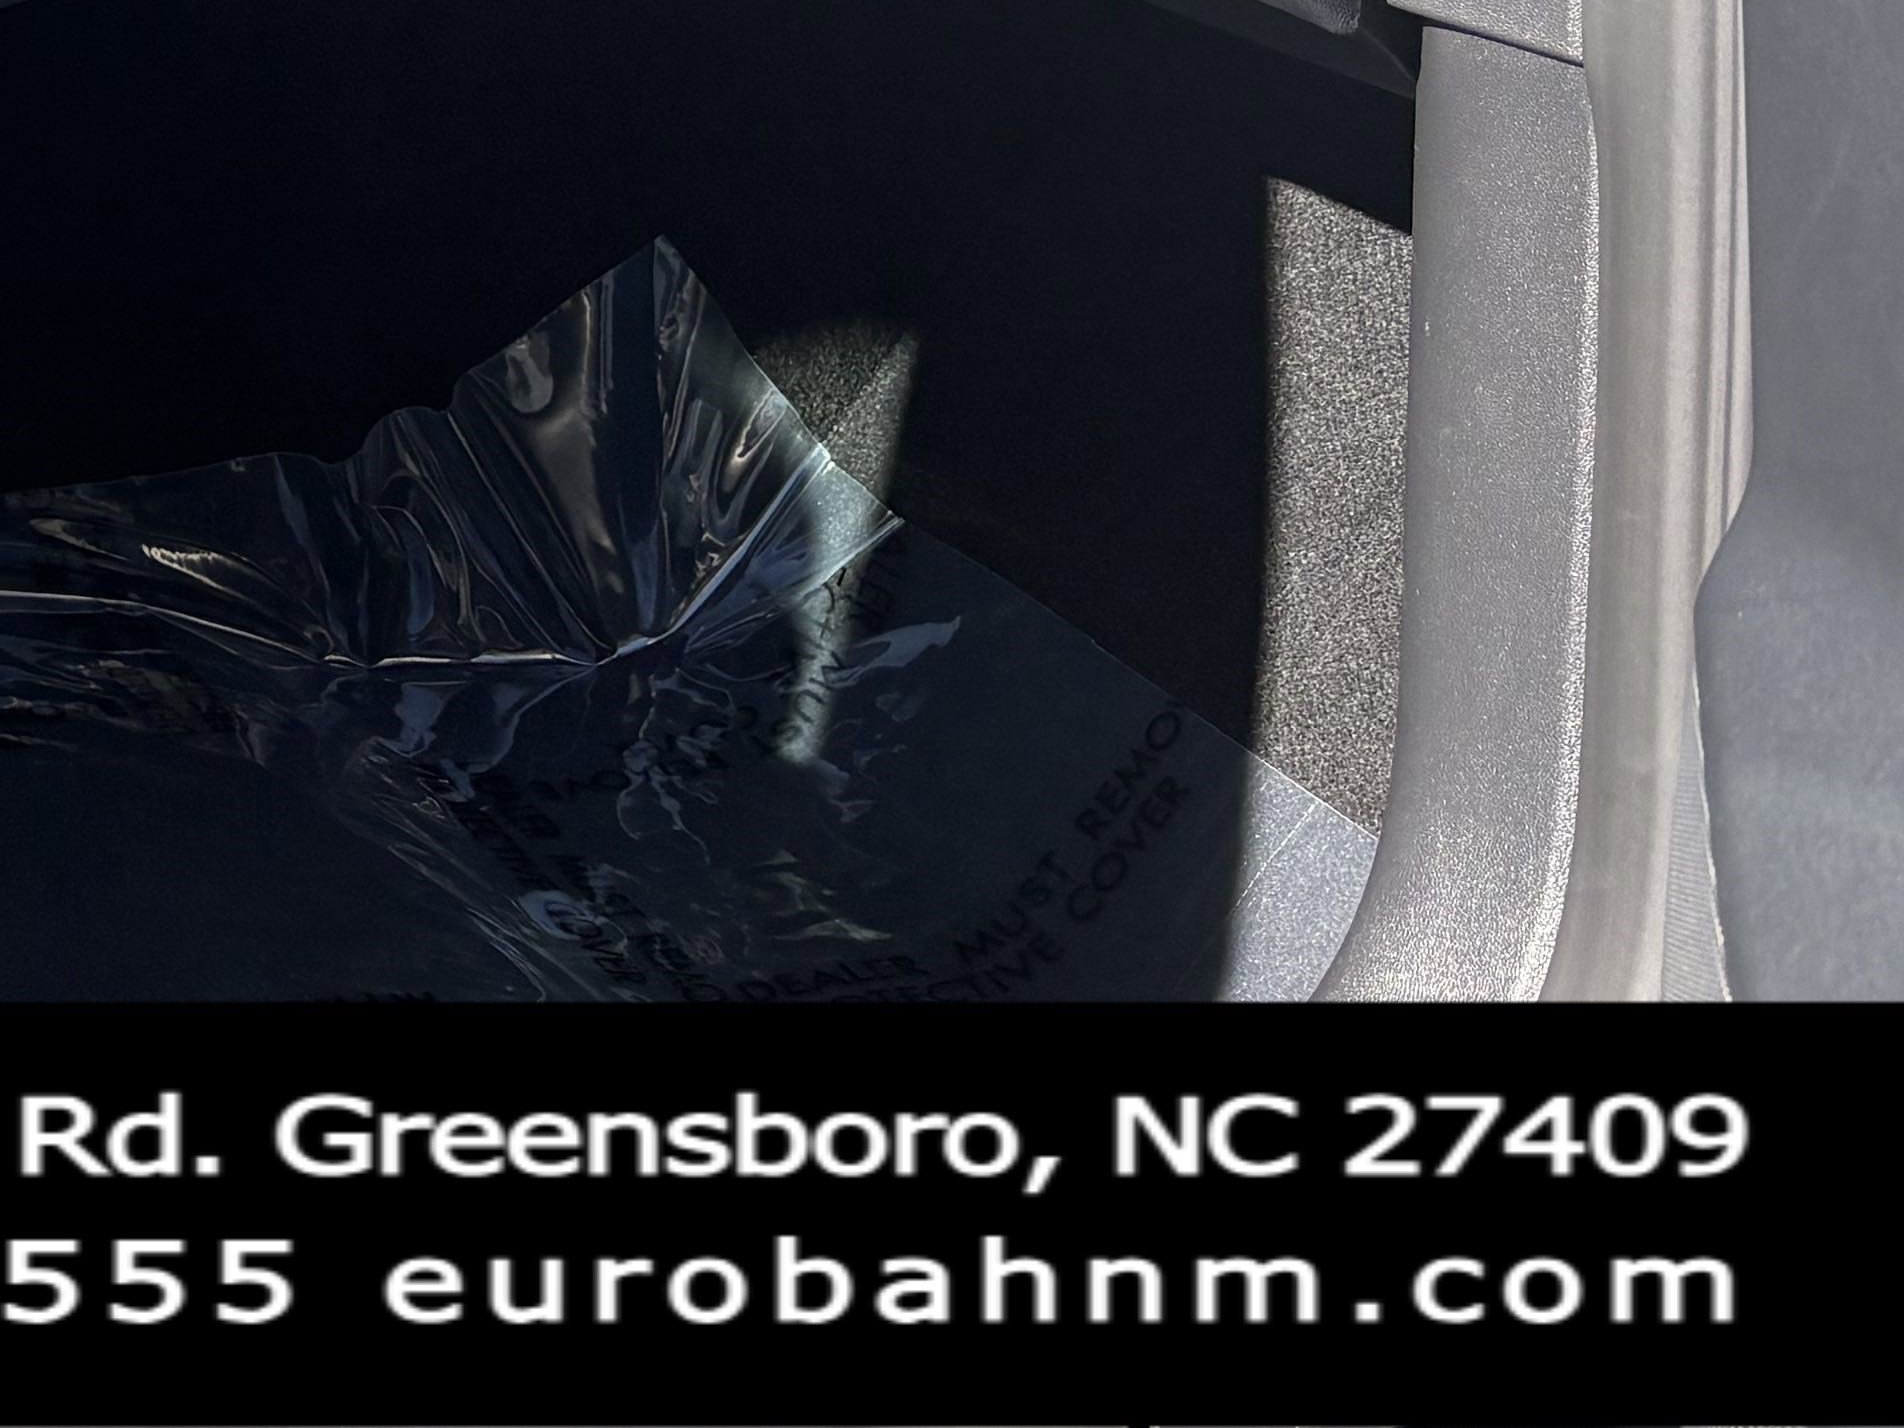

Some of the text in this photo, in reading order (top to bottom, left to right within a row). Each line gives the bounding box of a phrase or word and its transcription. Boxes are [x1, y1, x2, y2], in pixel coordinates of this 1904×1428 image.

[954, 850, 1070, 962] MUST
[1073, 700, 1183, 841] REMO
[1066, 775, 1190, 923] COVER
